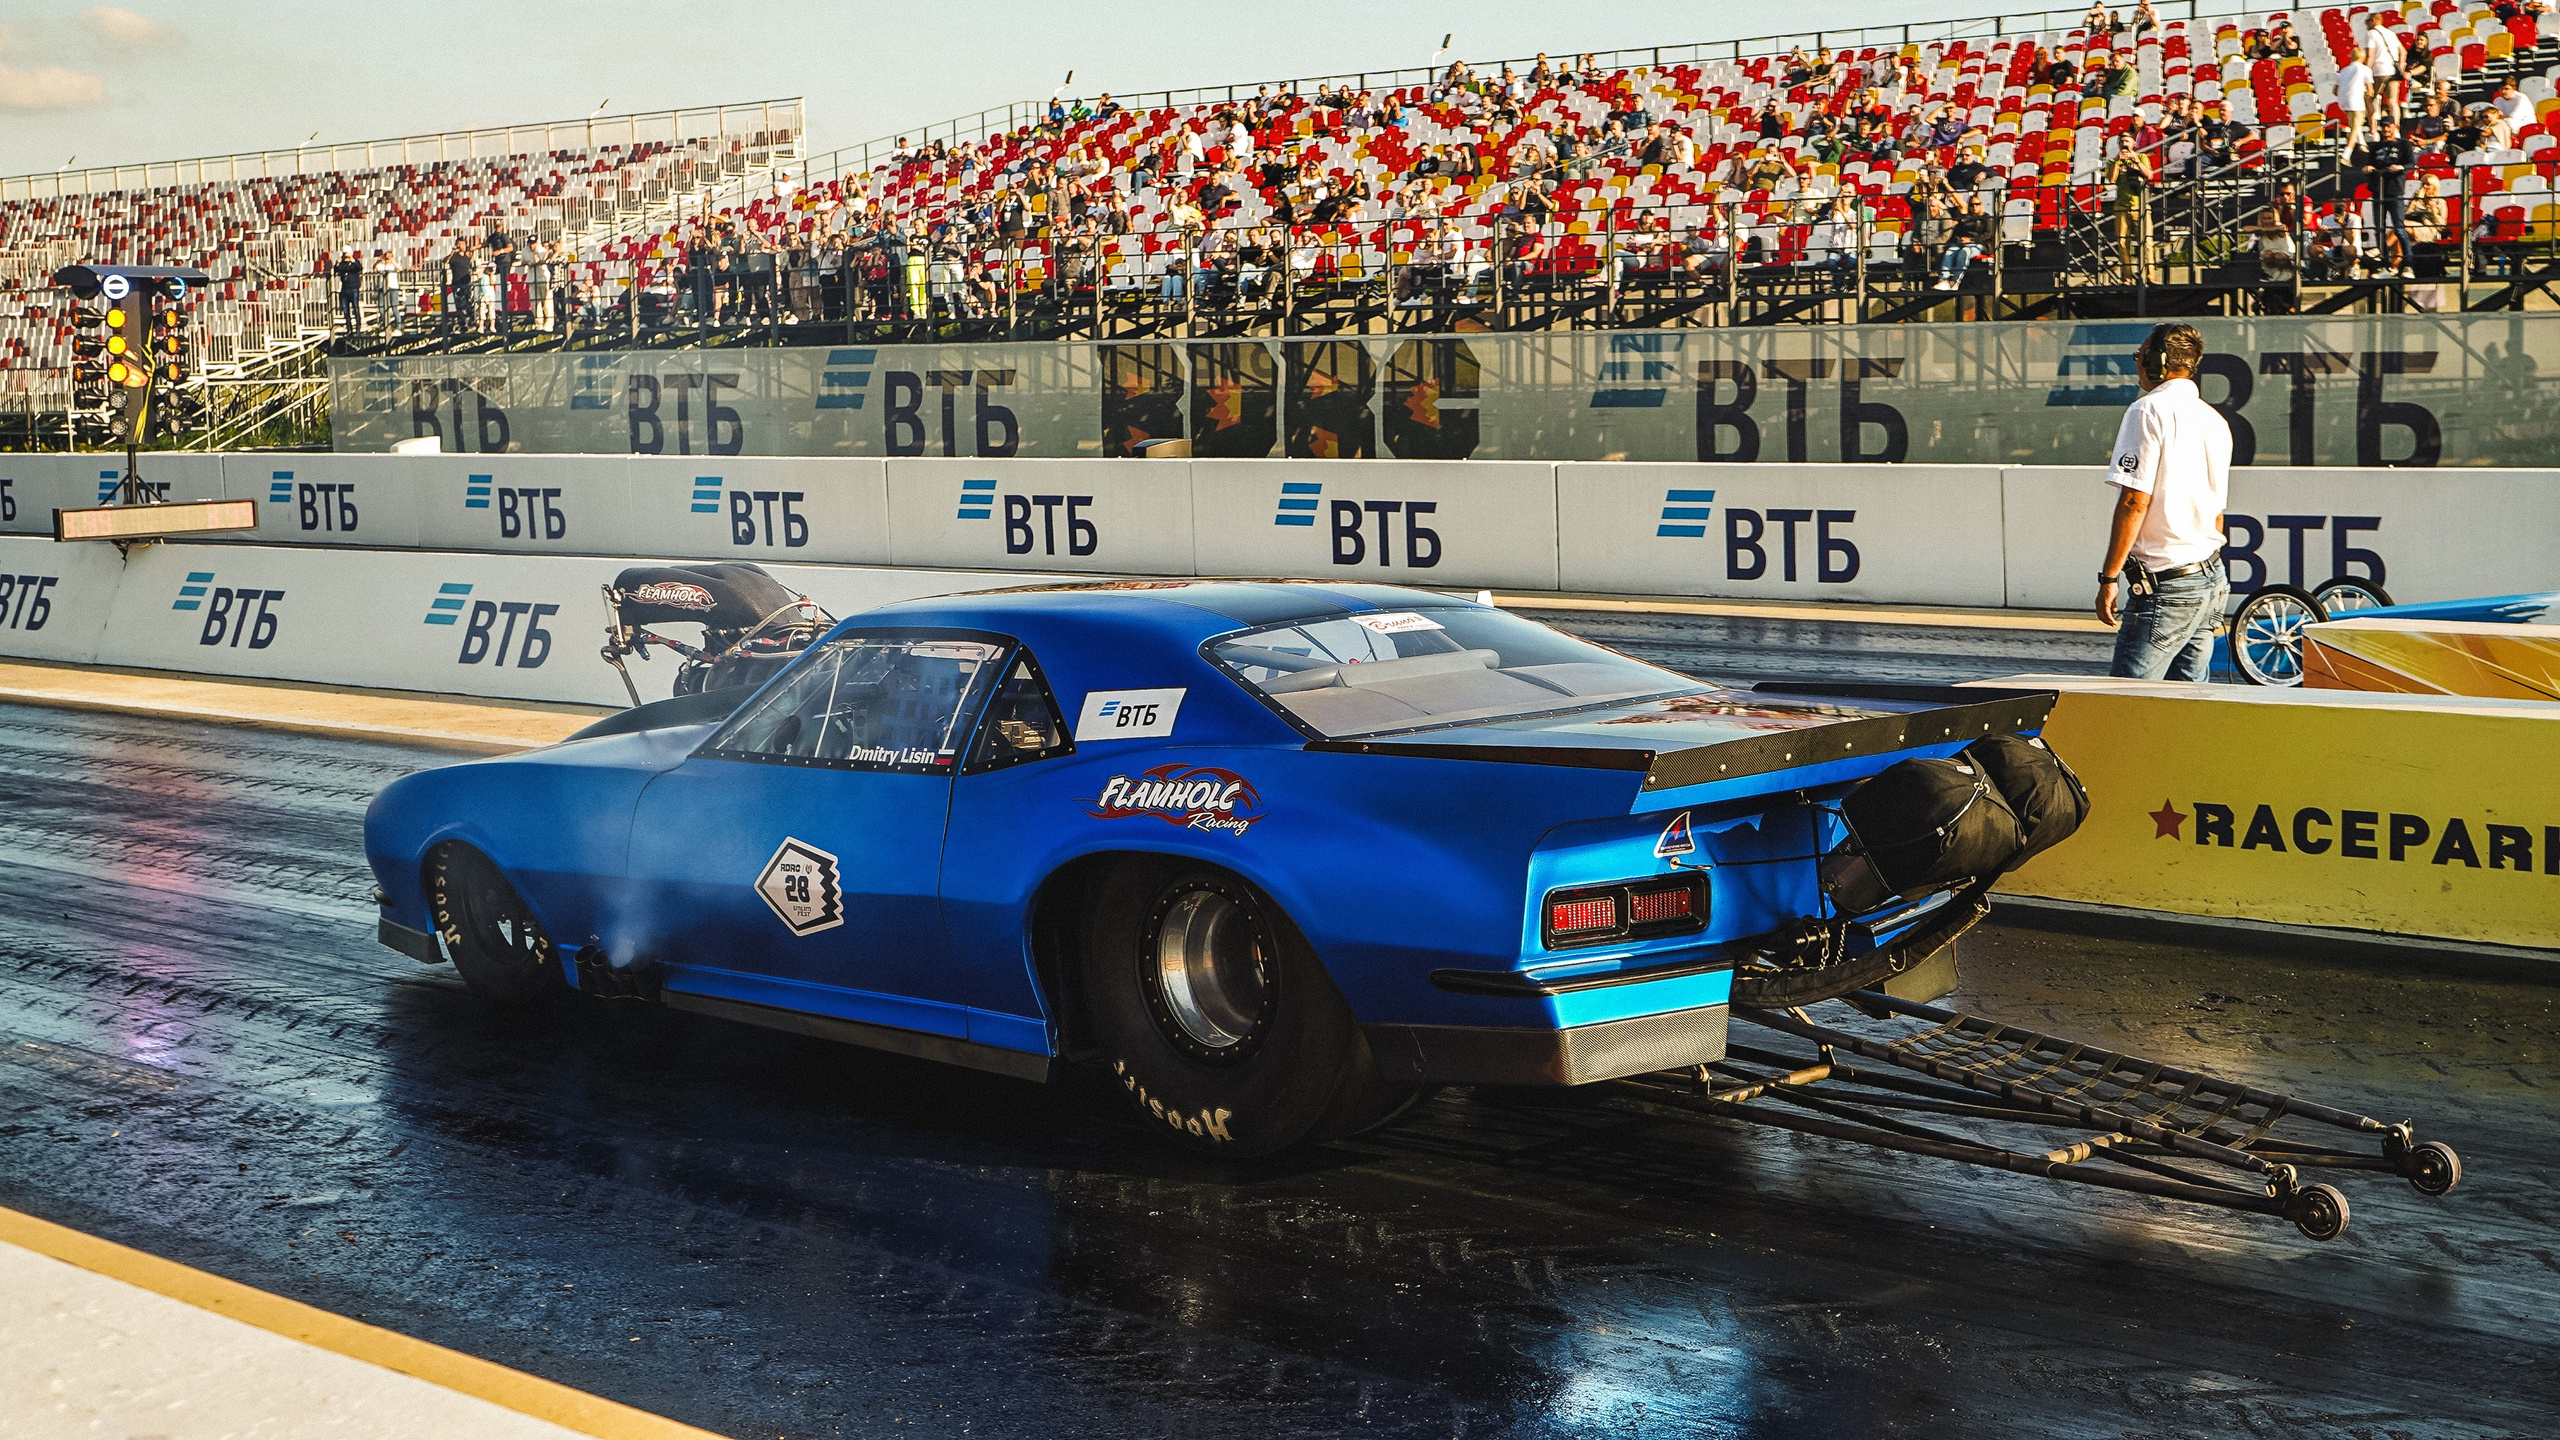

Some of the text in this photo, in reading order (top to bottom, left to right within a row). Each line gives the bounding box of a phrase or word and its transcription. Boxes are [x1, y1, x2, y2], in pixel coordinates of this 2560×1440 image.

[628, 373, 745, 456] ВТБ
[884, 369, 1020, 457] ВТБ
[1696, 357, 1910, 463] ВТБ
[300, 483, 359, 532] ВТБ
[498, 487, 567, 540] ВТБ
[729, 490, 809, 548] ВТБ
[1003, 494, 1098, 557] ВТБ
[1330, 499, 1442, 568] ВТБ
[1724, 507, 1861, 584] ВТБ
[200, 587, 286, 650] ВТБ
[458, 600, 560, 669] ВТБ
[1115, 703, 1160, 728] ВТБ
[848, 744, 936, 767] Dmitry Lisin
[1098, 774, 1243, 812] FLAMHOLC
[1186, 811, 1250, 837] Racing
[780, 863, 801, 873] RDRC
[784, 874, 811, 903] 28
